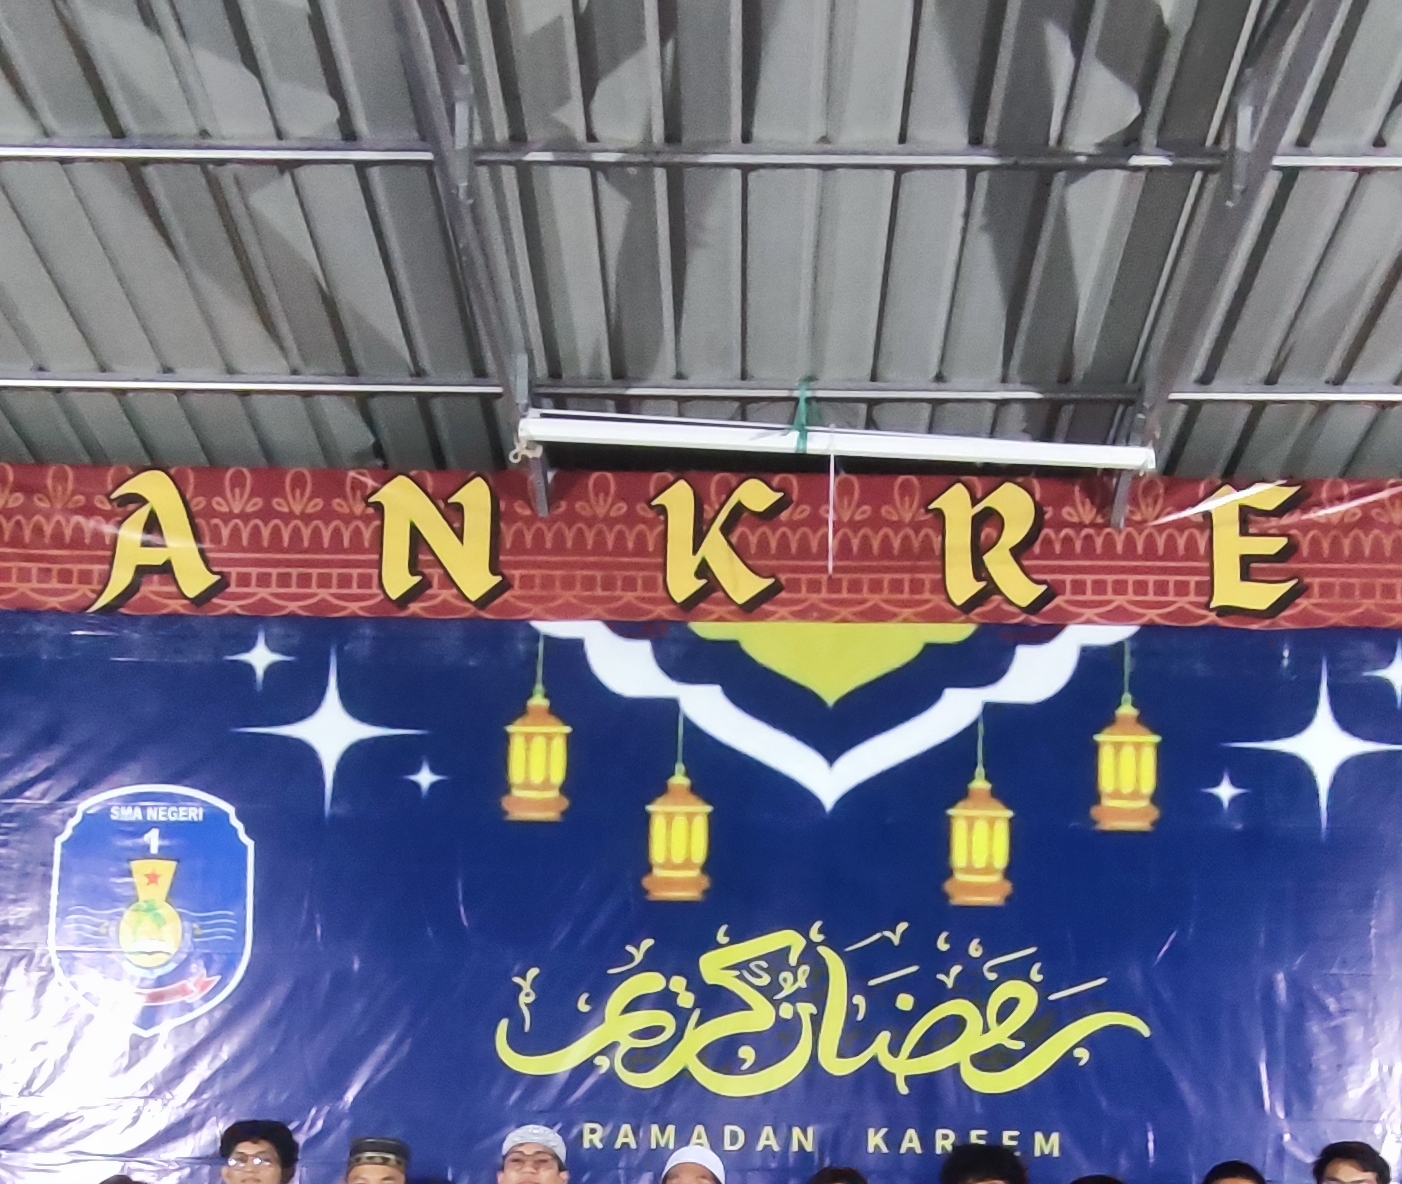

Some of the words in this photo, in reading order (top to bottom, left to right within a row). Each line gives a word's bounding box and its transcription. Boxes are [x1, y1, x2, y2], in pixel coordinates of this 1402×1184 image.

[110, 806, 142, 821] SMA
[147, 806, 204, 822] NEGERI
[143, 827, 160, 854] 1
[582, 1122, 816, 1153] RAMADAN
